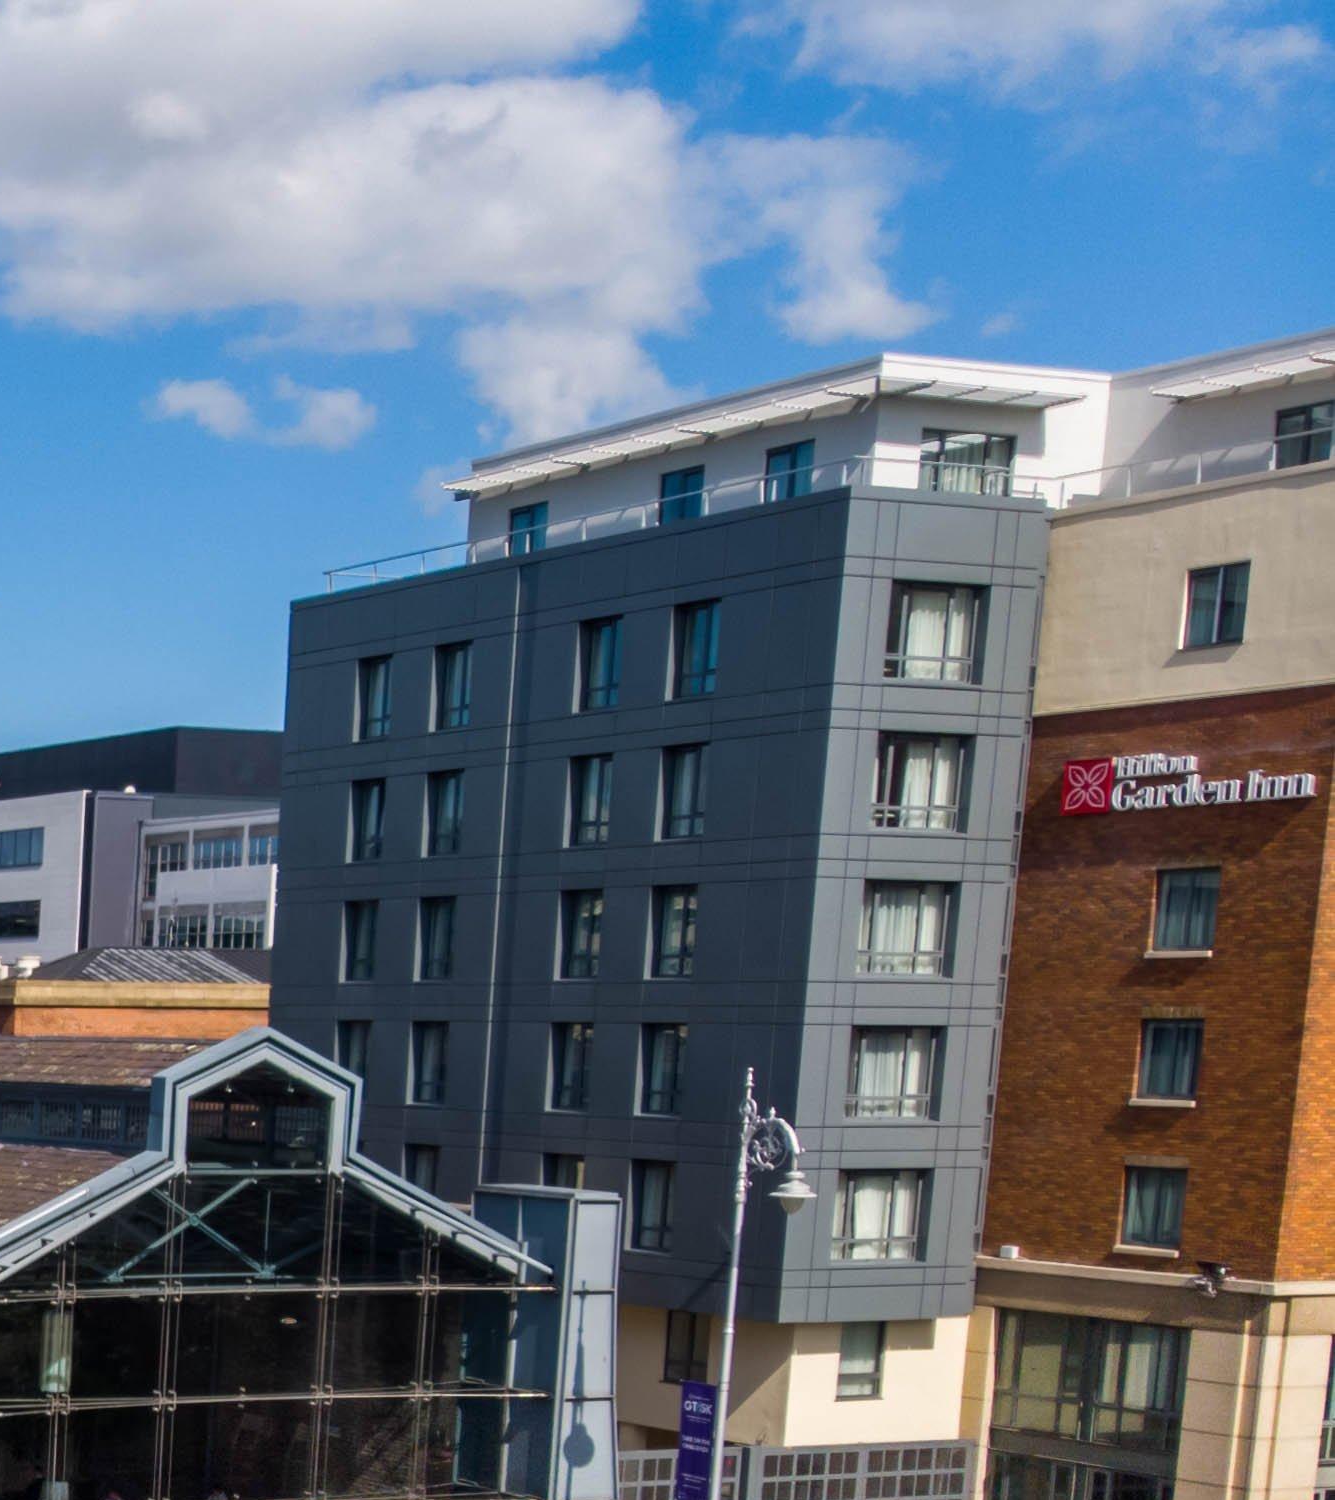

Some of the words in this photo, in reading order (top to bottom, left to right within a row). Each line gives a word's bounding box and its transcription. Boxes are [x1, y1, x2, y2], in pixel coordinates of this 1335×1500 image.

[1112, 752, 1199, 778] Hilton
[1111, 774, 1243, 811] Garden
[1245, 769, 1317, 801] Inn
